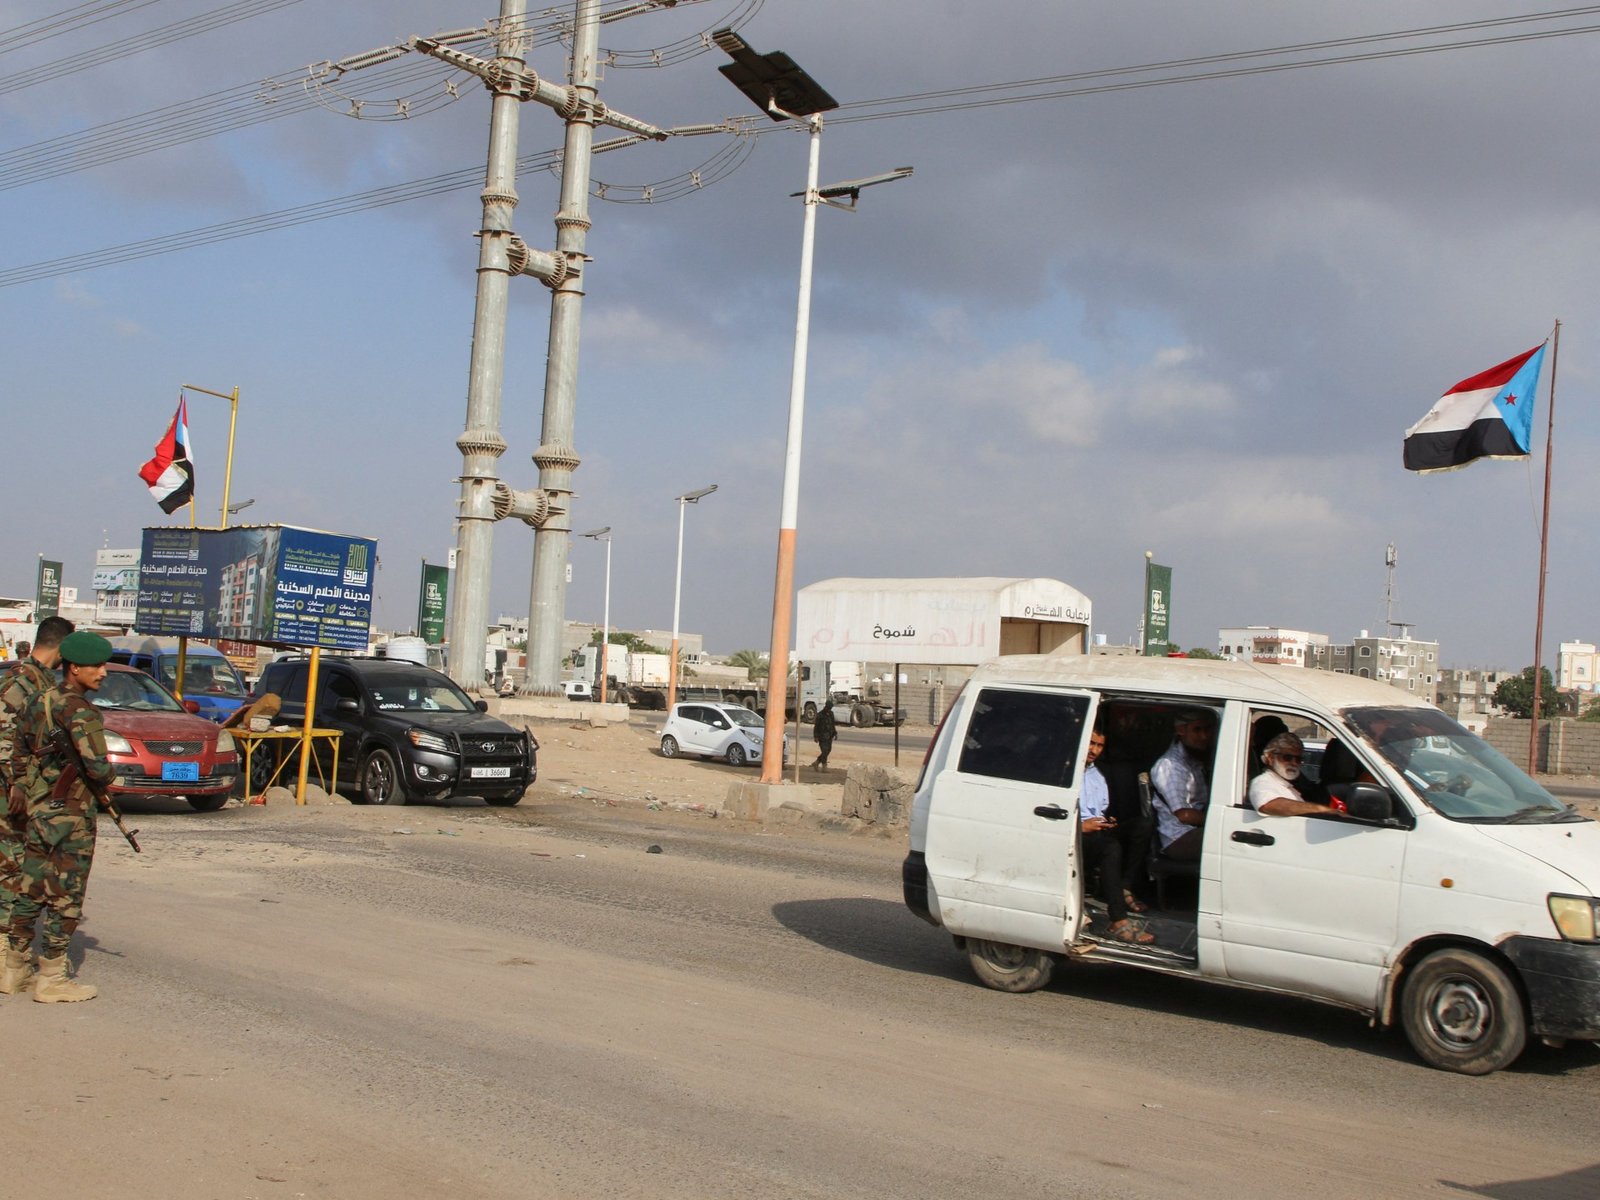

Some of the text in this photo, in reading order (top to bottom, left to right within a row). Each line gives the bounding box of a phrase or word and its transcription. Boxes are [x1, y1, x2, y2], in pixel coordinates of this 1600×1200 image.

[142, 564, 207, 576] مدينة الأحلام السكنية
[277, 581, 371, 602] مدينة الأحلام السكنية
[1065, 607, 1090, 622] برعاية
[873, 623, 915, 639] شموخ
